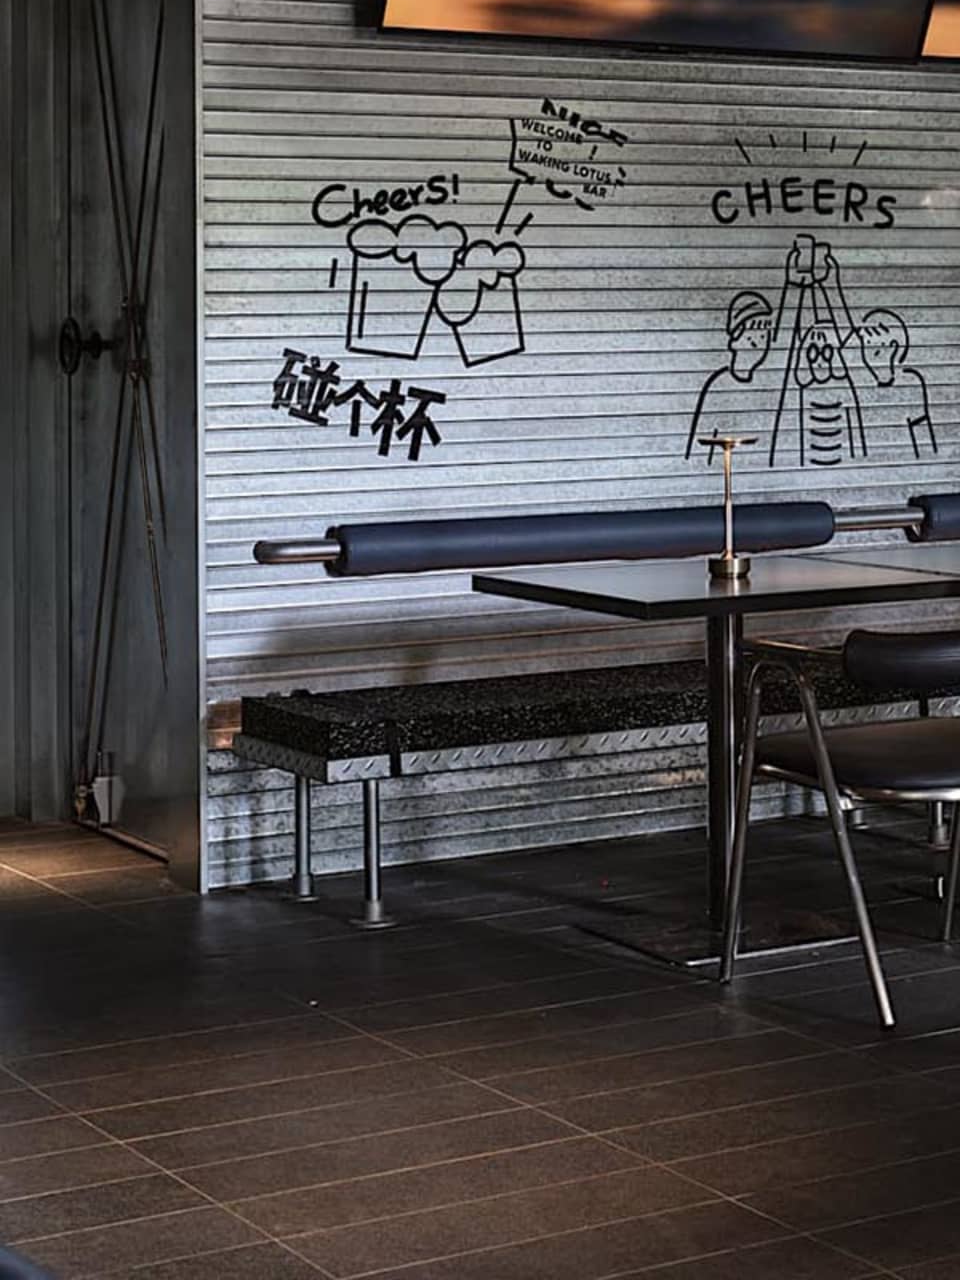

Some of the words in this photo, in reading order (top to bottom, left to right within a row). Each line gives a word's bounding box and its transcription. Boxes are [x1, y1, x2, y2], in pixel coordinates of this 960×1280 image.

[522, 118, 583, 144] WELCOME
[537, 140, 553, 152] TO
[519, 149, 570, 173] WAKING
[573, 164, 612, 185] LOTUS
[583, 183, 607, 199] BAR
[712, 177, 897, 229] CHEERS
[272, 348, 446, 462] 碰个杯
